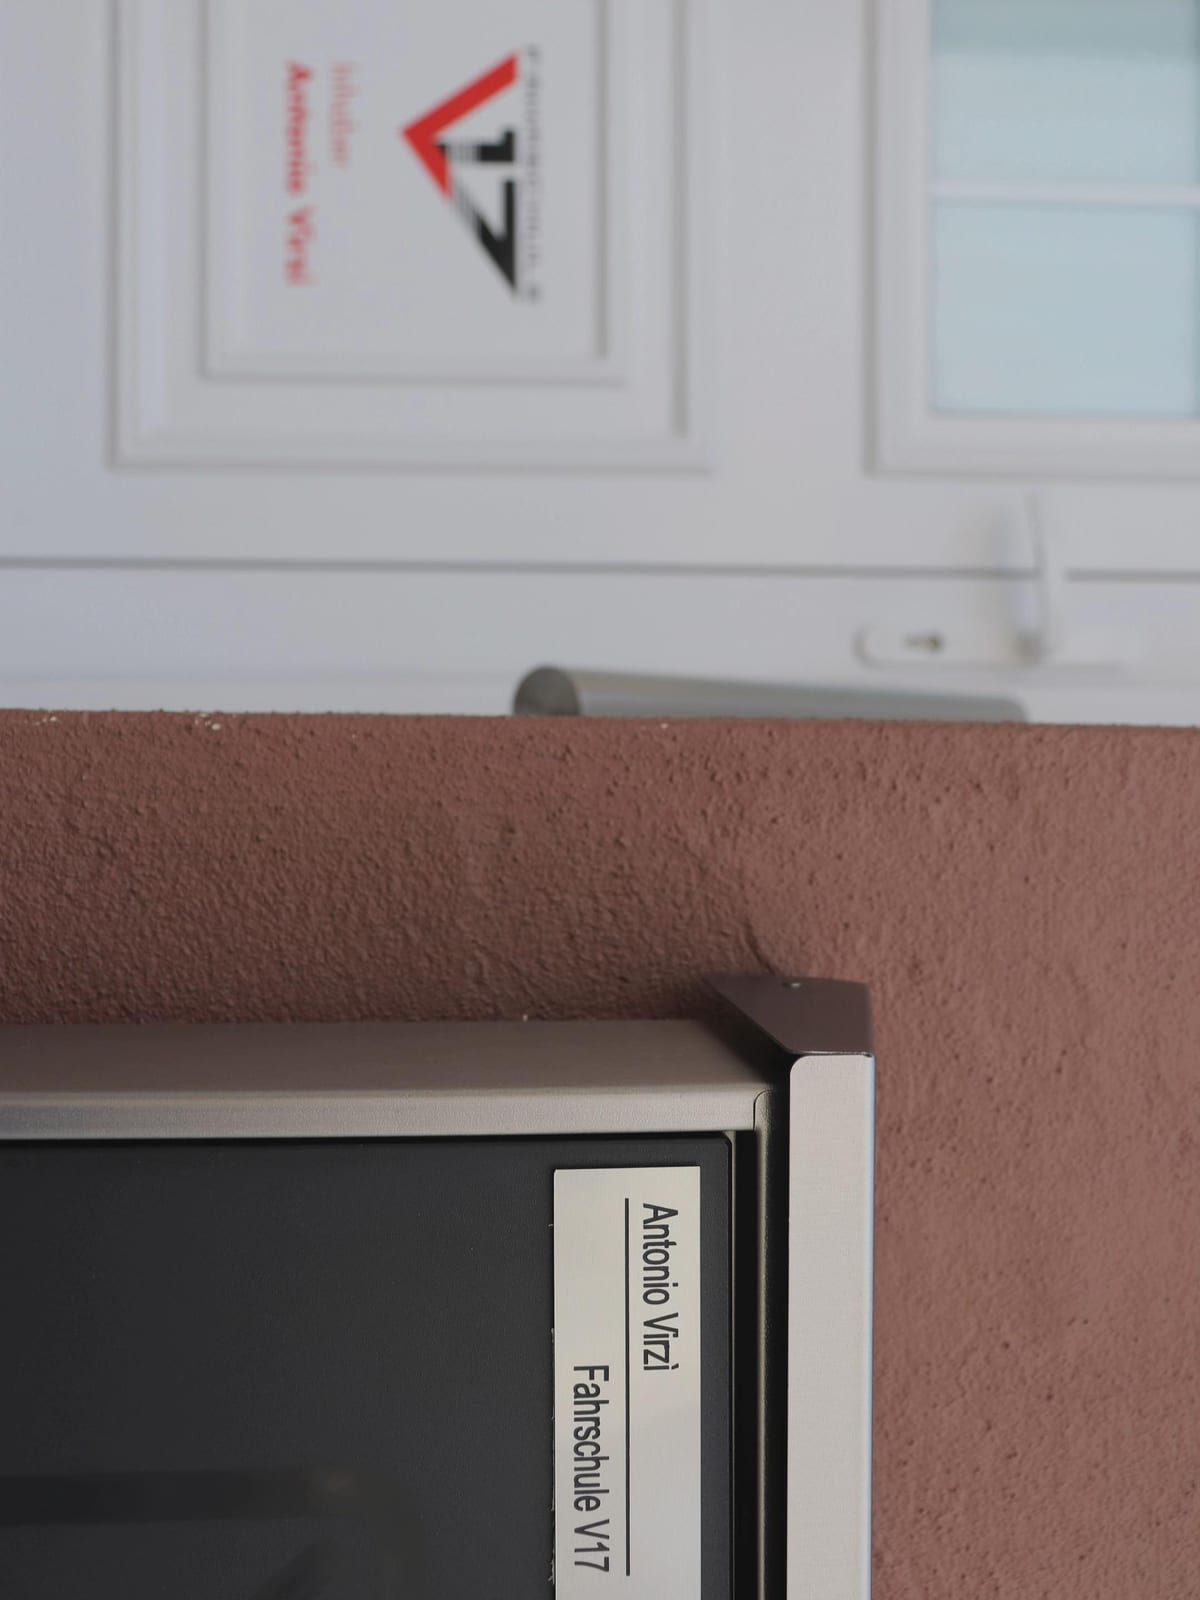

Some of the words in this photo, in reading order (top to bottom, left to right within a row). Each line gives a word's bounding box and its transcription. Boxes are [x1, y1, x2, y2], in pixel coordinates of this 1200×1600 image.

[642, 1202, 679, 1306] Antonio
[643, 1311, 680, 1371] Virzì
[572, 1364, 610, 1512] Fahrschule
[573, 1518, 611, 1573] V17
